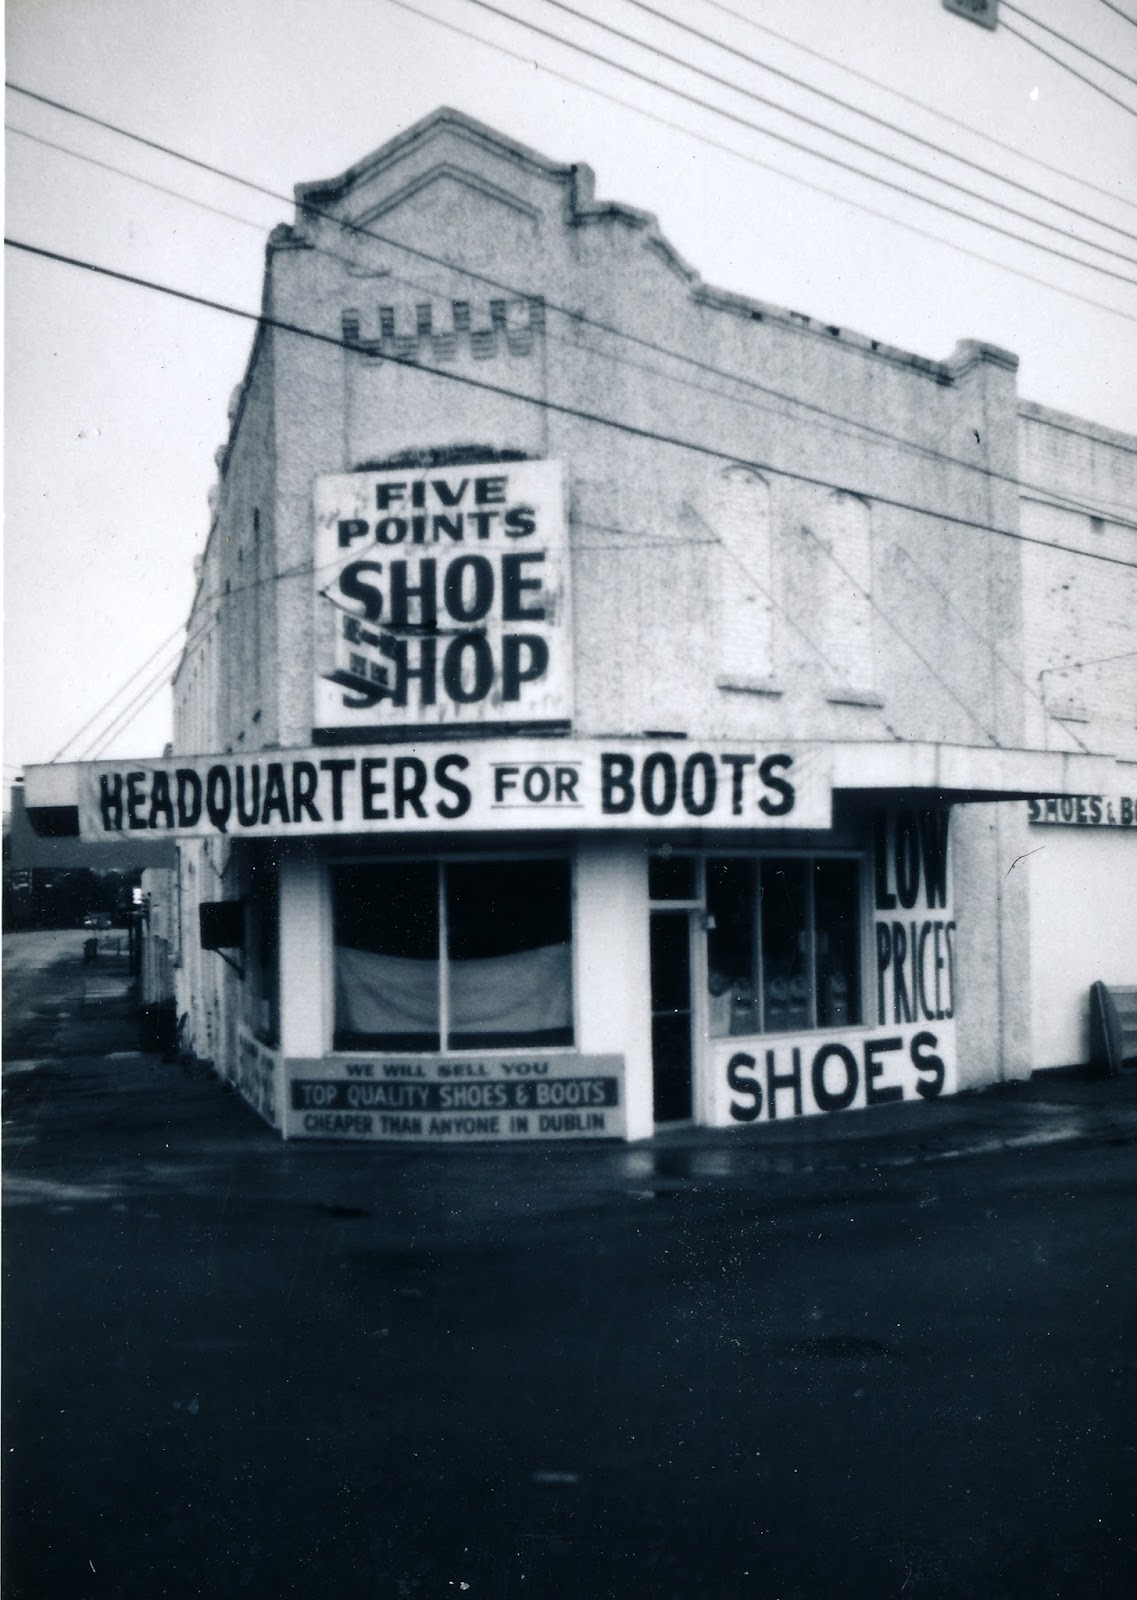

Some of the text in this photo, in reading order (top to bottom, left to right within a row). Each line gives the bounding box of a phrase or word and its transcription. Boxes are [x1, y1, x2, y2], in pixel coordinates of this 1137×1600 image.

[376, 476, 508, 510] FIVE
[338, 507, 536, 547] POINTS
[339, 551, 546, 622] SHOE
[100, 751, 796, 834] HEADQUARTERS FOR BOOTS
[1027, 796, 1103, 824] SHOES
[1120, 796, 1137, 825] B
[874, 807, 950, 910] LOW
[876, 920, 956, 1026] PRICES
[345, 1061, 549, 1077] WE WILL SELL YOU
[727, 1031, 946, 1122] SHOES
[303, 1080, 606, 1108] TOP QUALITY SHOES & BOOTS
[303, 1113, 606, 1135] CHEAPER THAN ANYONE IN DUBLIN
